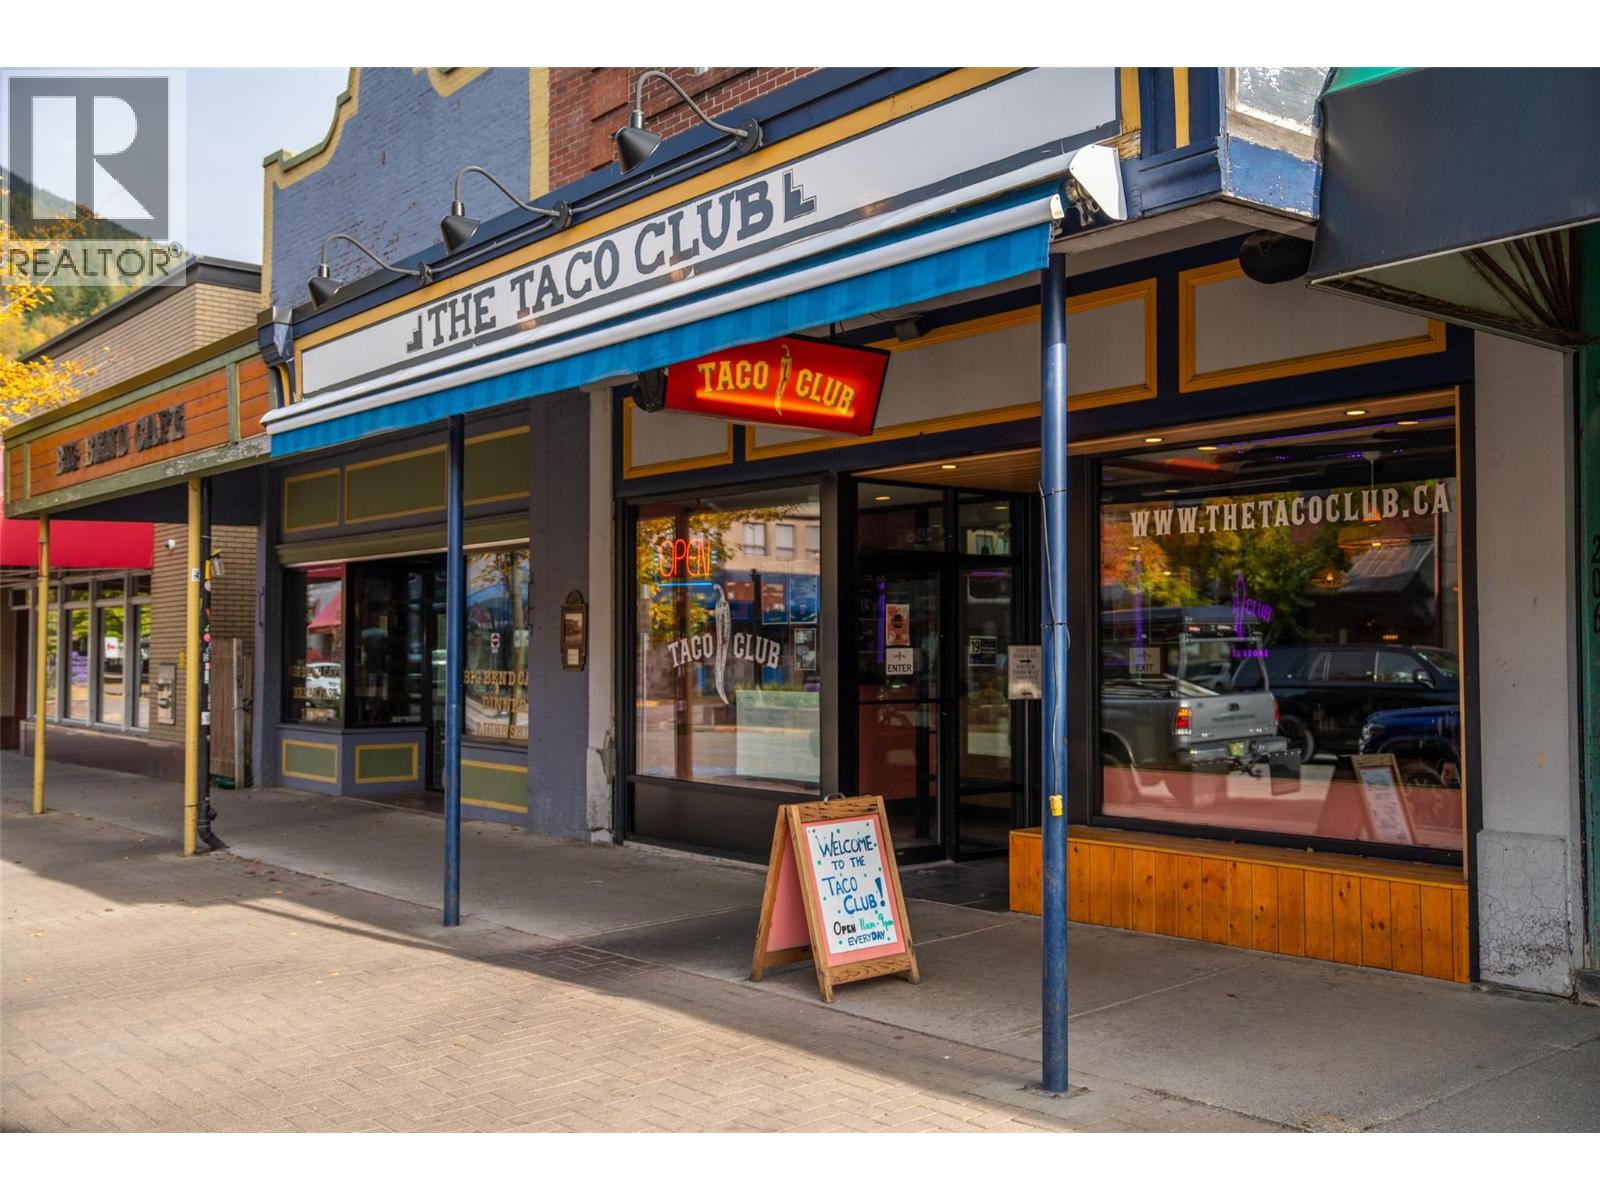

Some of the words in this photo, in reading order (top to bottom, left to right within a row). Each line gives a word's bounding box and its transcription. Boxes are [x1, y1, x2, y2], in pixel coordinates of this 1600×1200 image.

[427, 286, 496, 347] THE
[510, 240, 620, 319] TACO
[634, 180, 774, 275] CLUB
[697, 360, 769, 393] TACO
[795, 368, 855, 415] CLUB
[1131, 482, 1450, 537] WWW.THETACOCLUB.CA
[658, 538, 711, 578] OPEN
[1246, 598, 1274, 623] CLUB
[667, 632, 714, 668] TACO
[733, 632, 781, 669] CLUB
[970, 640, 980, 653] 19
[463, 670, 482, 684] BIG
[483, 670, 516, 685] BEND
[887, 663, 912, 673] ENTER
[1136, 663, 1153, 672] EXIT
[815, 832, 873, 858] WELCOME
[832, 860, 845, 870] TO
[850, 856, 866, 868] THE
[821, 876, 858, 896] TACO
[833, 921, 857, 936] OPEN
[847, 931, 885, 947] EVERYDAY
